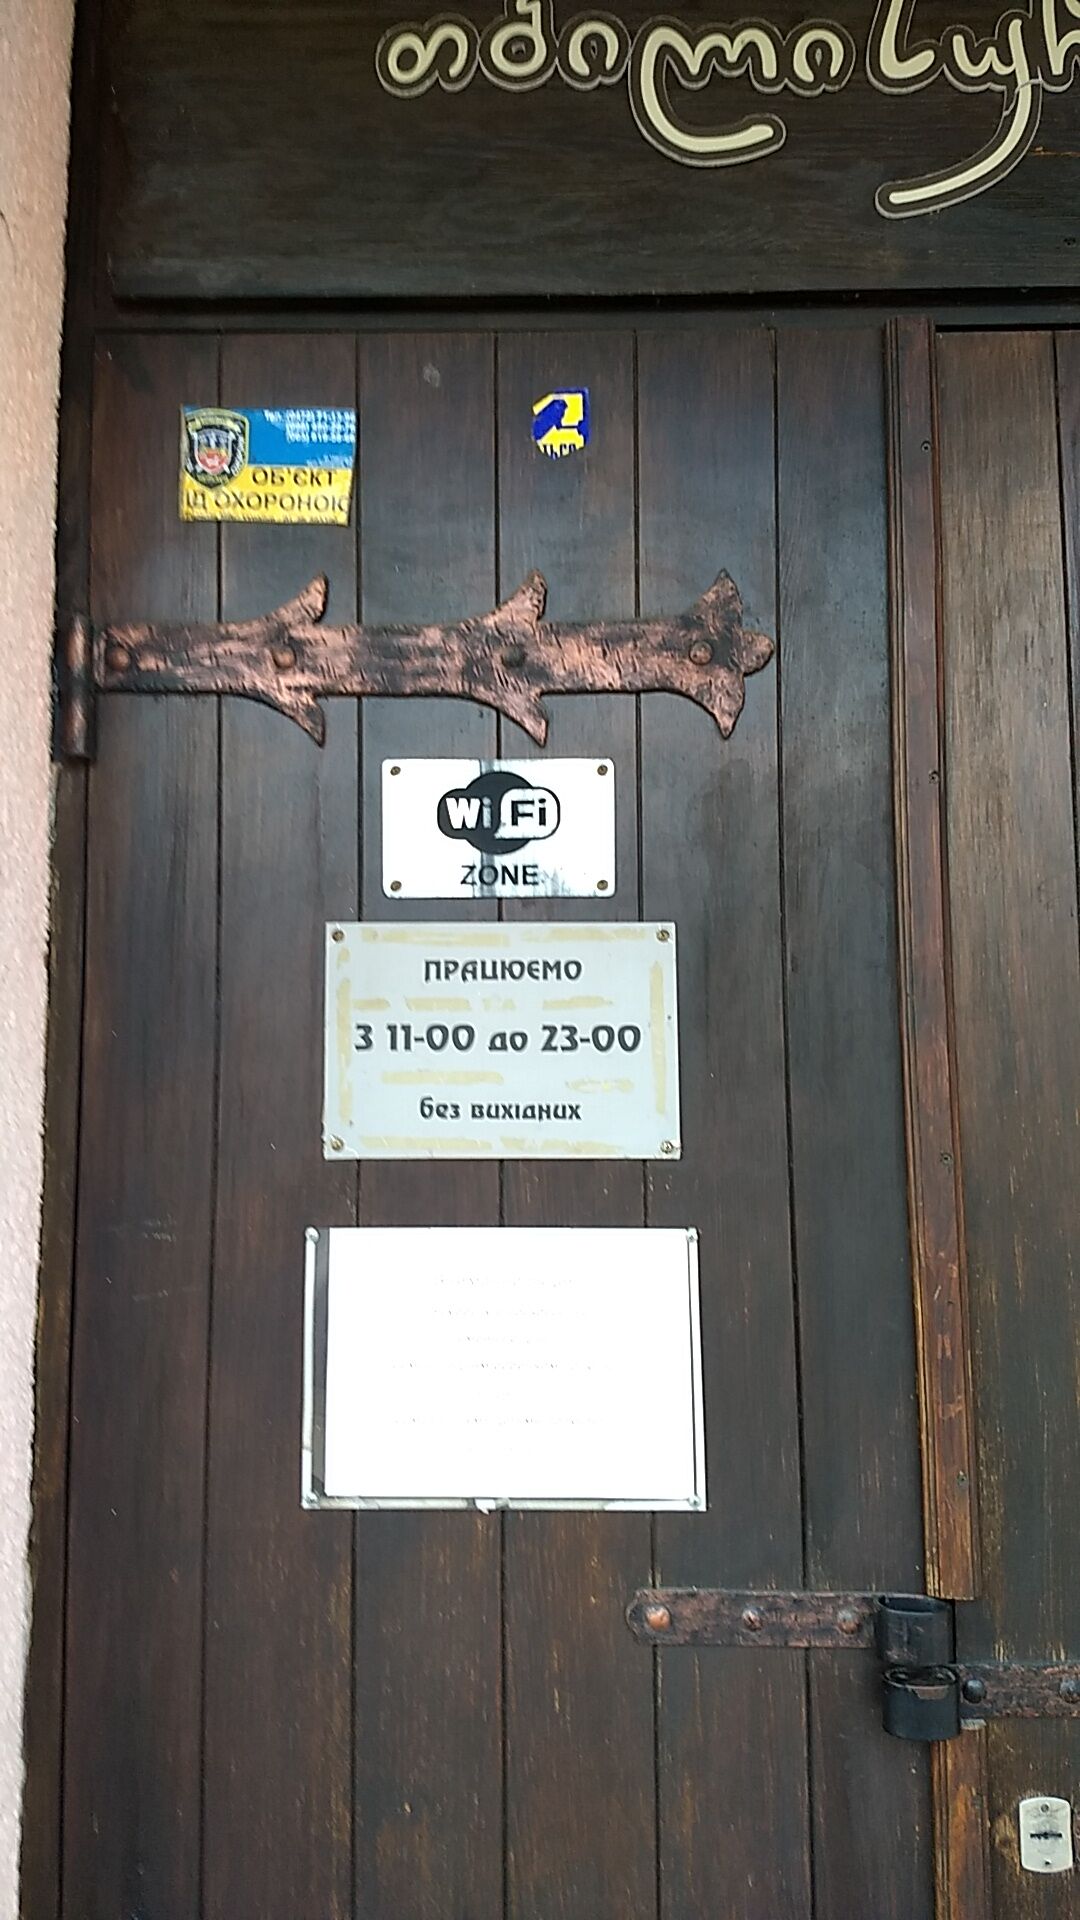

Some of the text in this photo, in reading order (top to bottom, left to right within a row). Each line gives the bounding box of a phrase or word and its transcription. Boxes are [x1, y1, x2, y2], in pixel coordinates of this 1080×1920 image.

[460, 864, 539, 886] ZONE
[424, 960, 582, 982] ПРАЦЮЄМО
[387, 1024, 475, 1051] 11-00
[488, 1032, 528, 1051] до
[541, 1025, 641, 1052] 23-00
[420, 1097, 581, 1121] без вихідних
